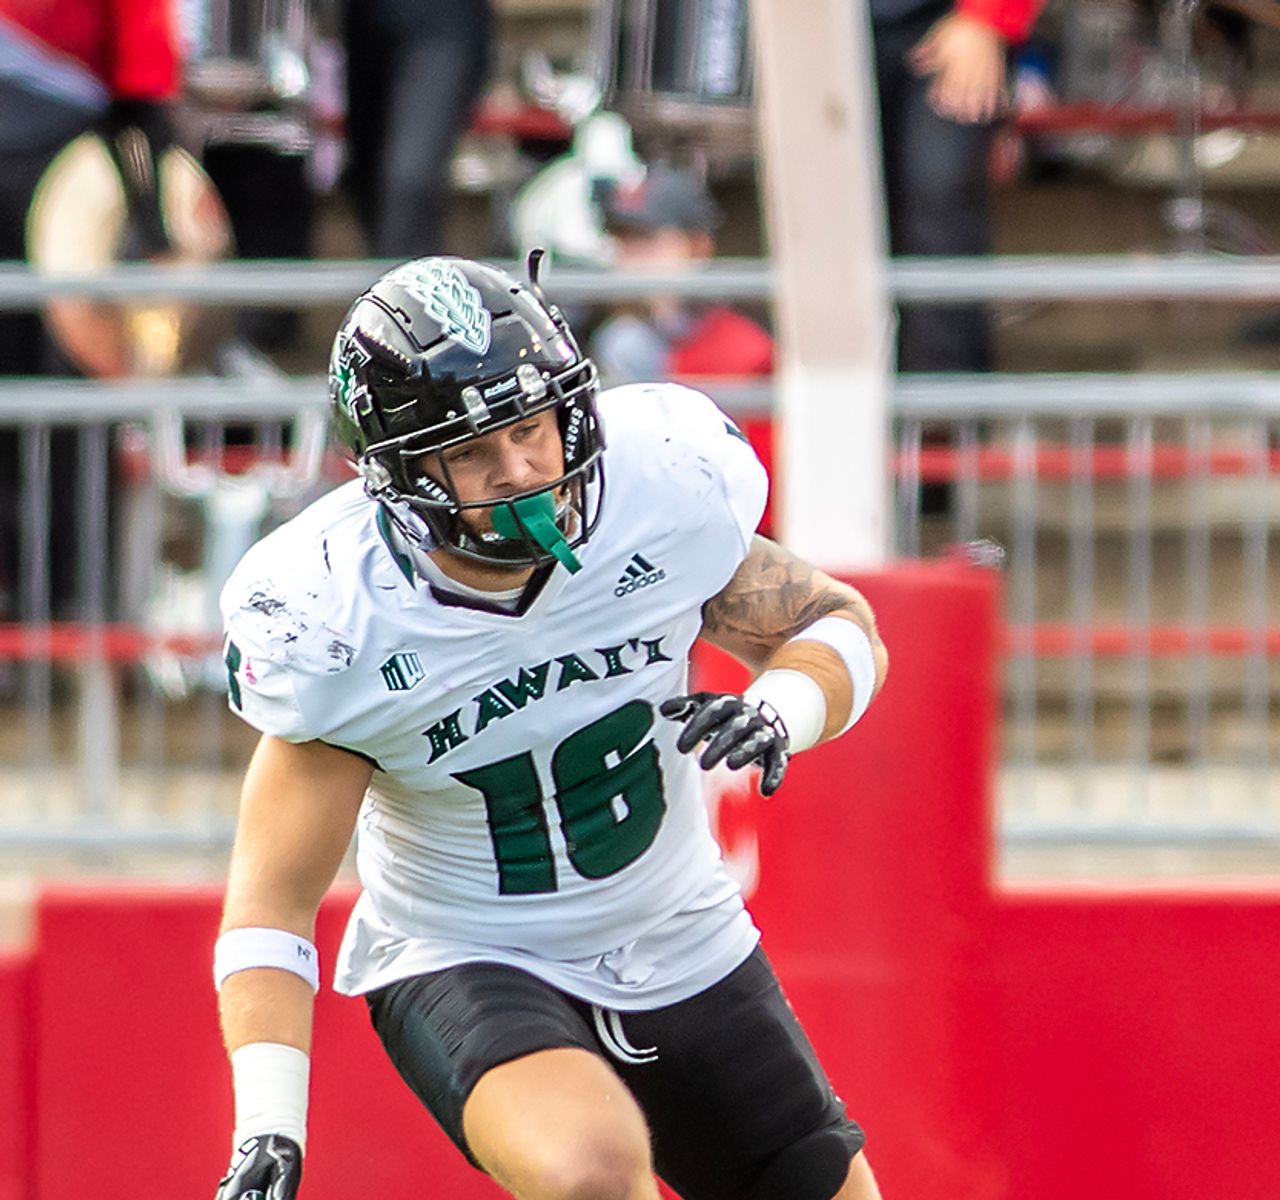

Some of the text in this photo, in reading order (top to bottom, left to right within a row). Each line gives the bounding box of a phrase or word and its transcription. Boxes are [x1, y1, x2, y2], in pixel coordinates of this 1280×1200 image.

[614, 568, 667, 598] adidas
[421, 634, 673, 764] HAWAI'I
[449, 698, 668, 896] 16
